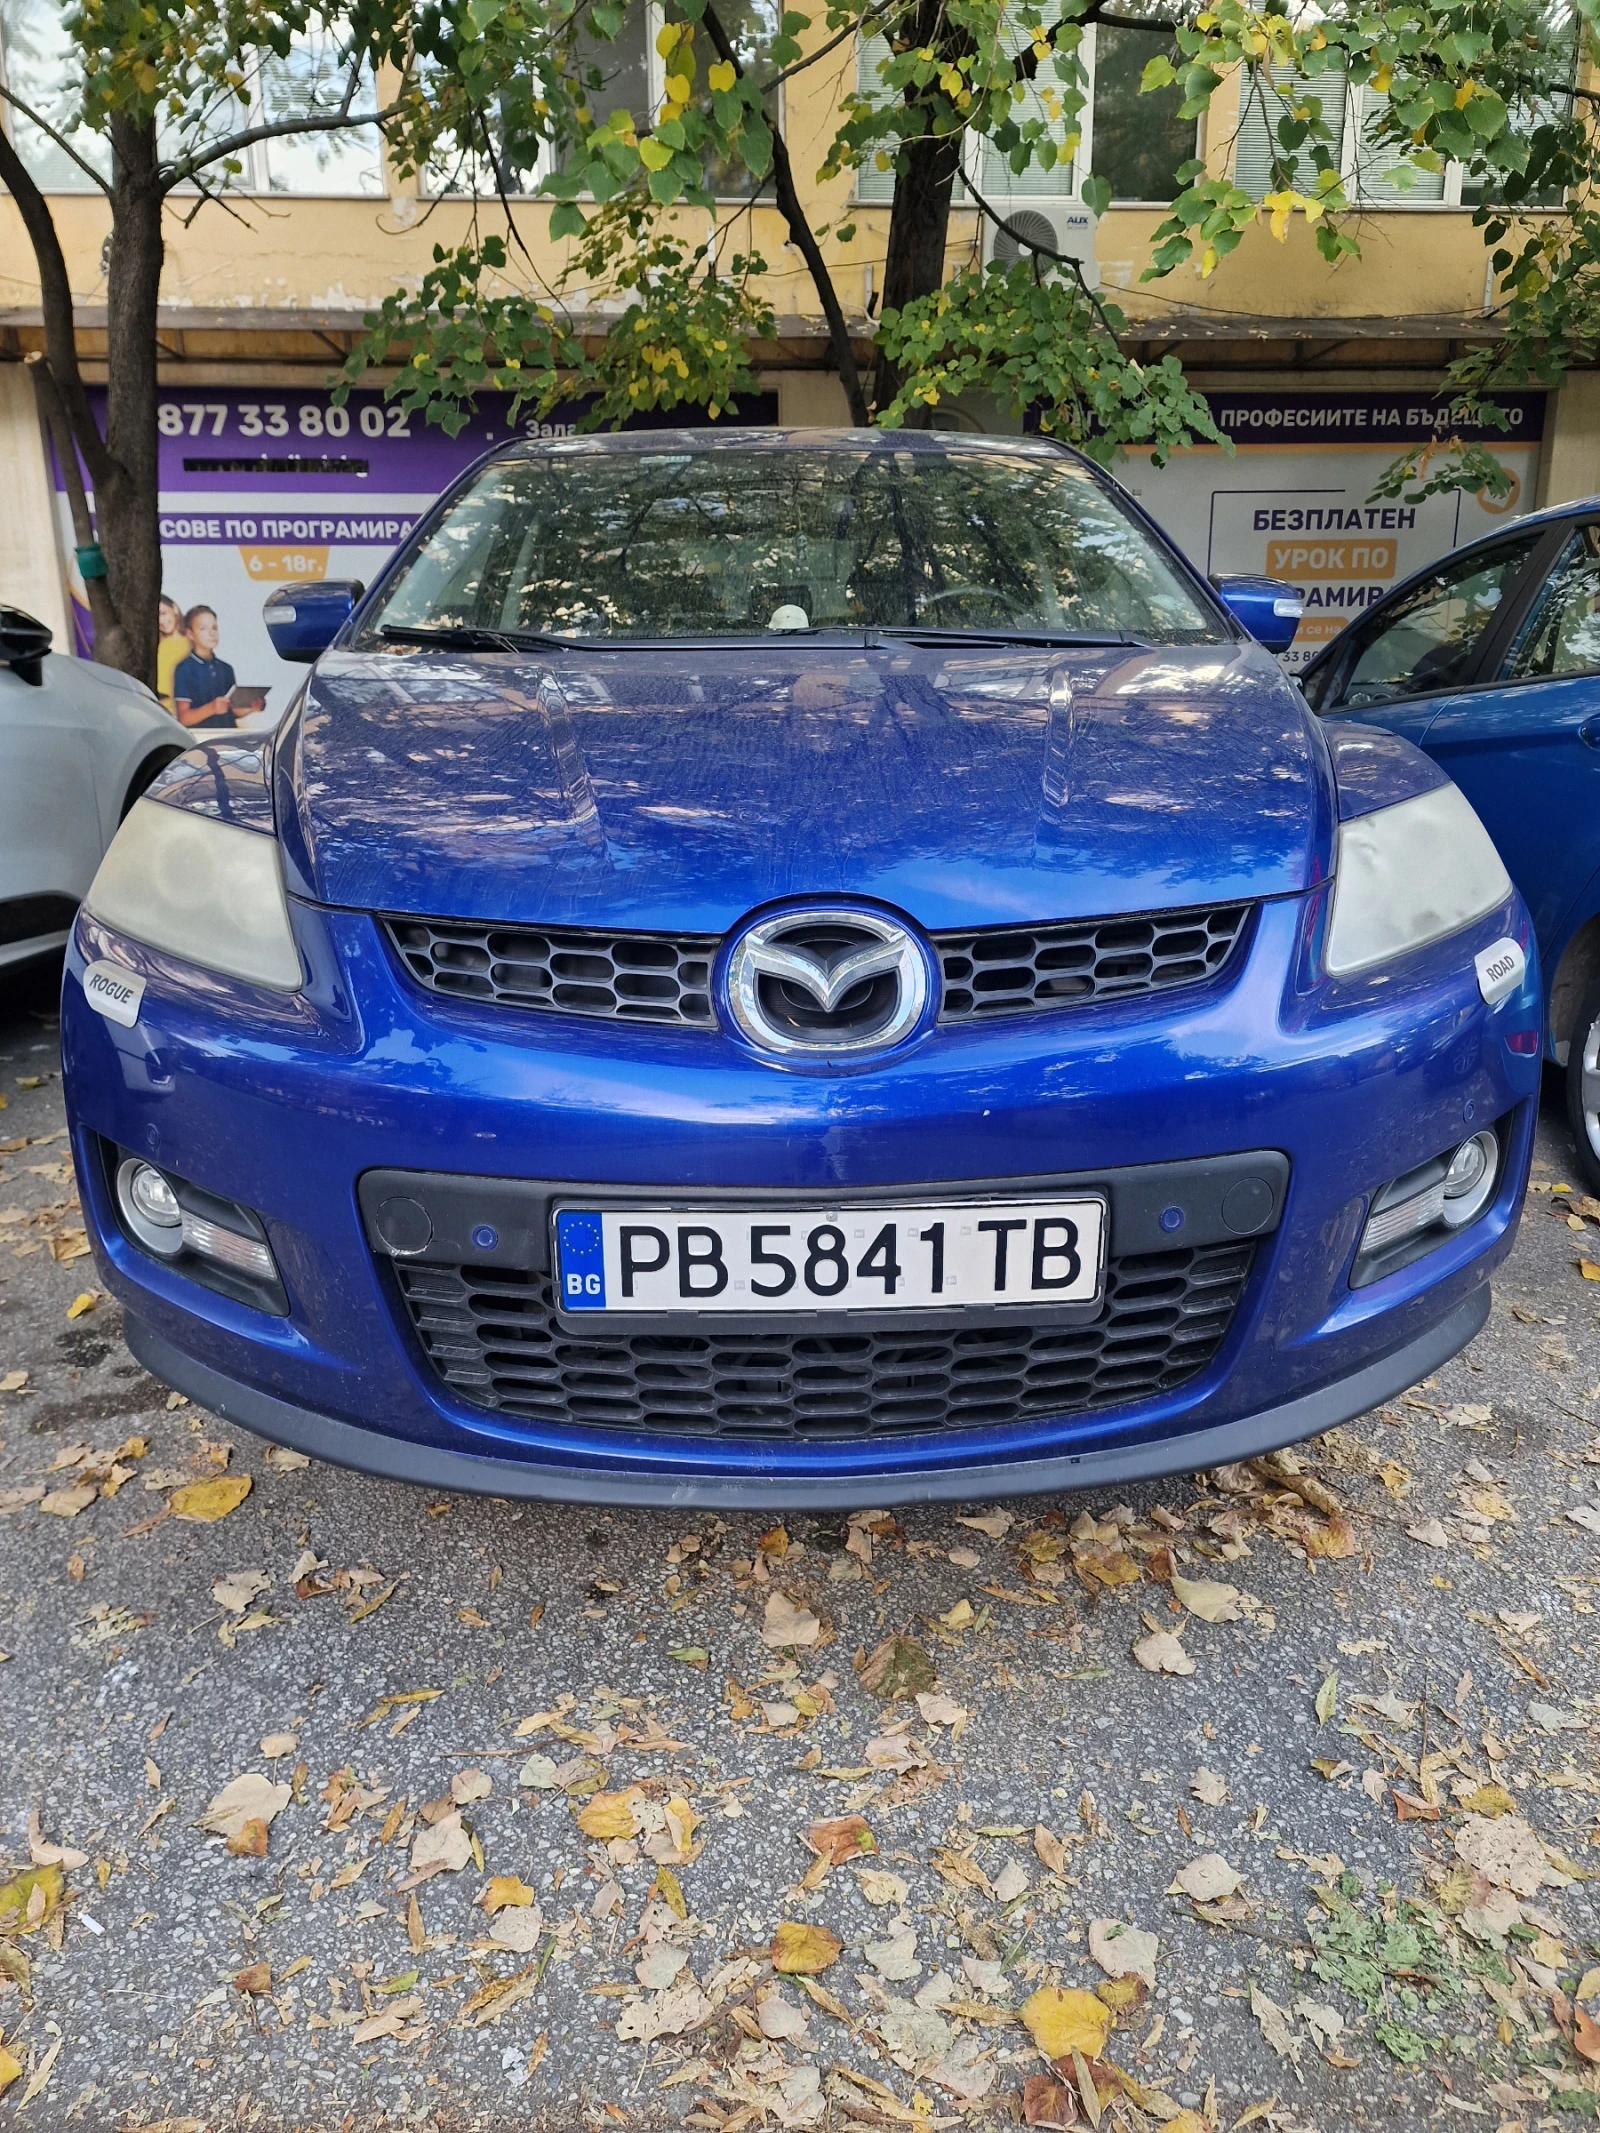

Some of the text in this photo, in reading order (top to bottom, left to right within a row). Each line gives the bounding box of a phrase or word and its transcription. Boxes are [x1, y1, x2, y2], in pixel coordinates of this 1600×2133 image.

[157, 403, 411, 437] 877 33 80 02
[1220, 408, 1368, 428] ПРОФЕСИИТЕ
[1372, 408, 1401, 426] НА
[225, 519, 257, 539] ПО
[1253, 508, 1416, 531] БЕЗПЛАТЕН
[249, 555, 263, 572] 6
[1274, 547, 1389, 570] УРОК ПО
[1306, 625, 1322, 634] се
[1282, 651, 1299, 662] 33
[1485, 955, 1515, 982] ROAD
[89, 973, 135, 1004] ROGUE
[620, 1217, 1082, 1298] PB 5841 TB
[567, 1273, 601, 1295] BG
